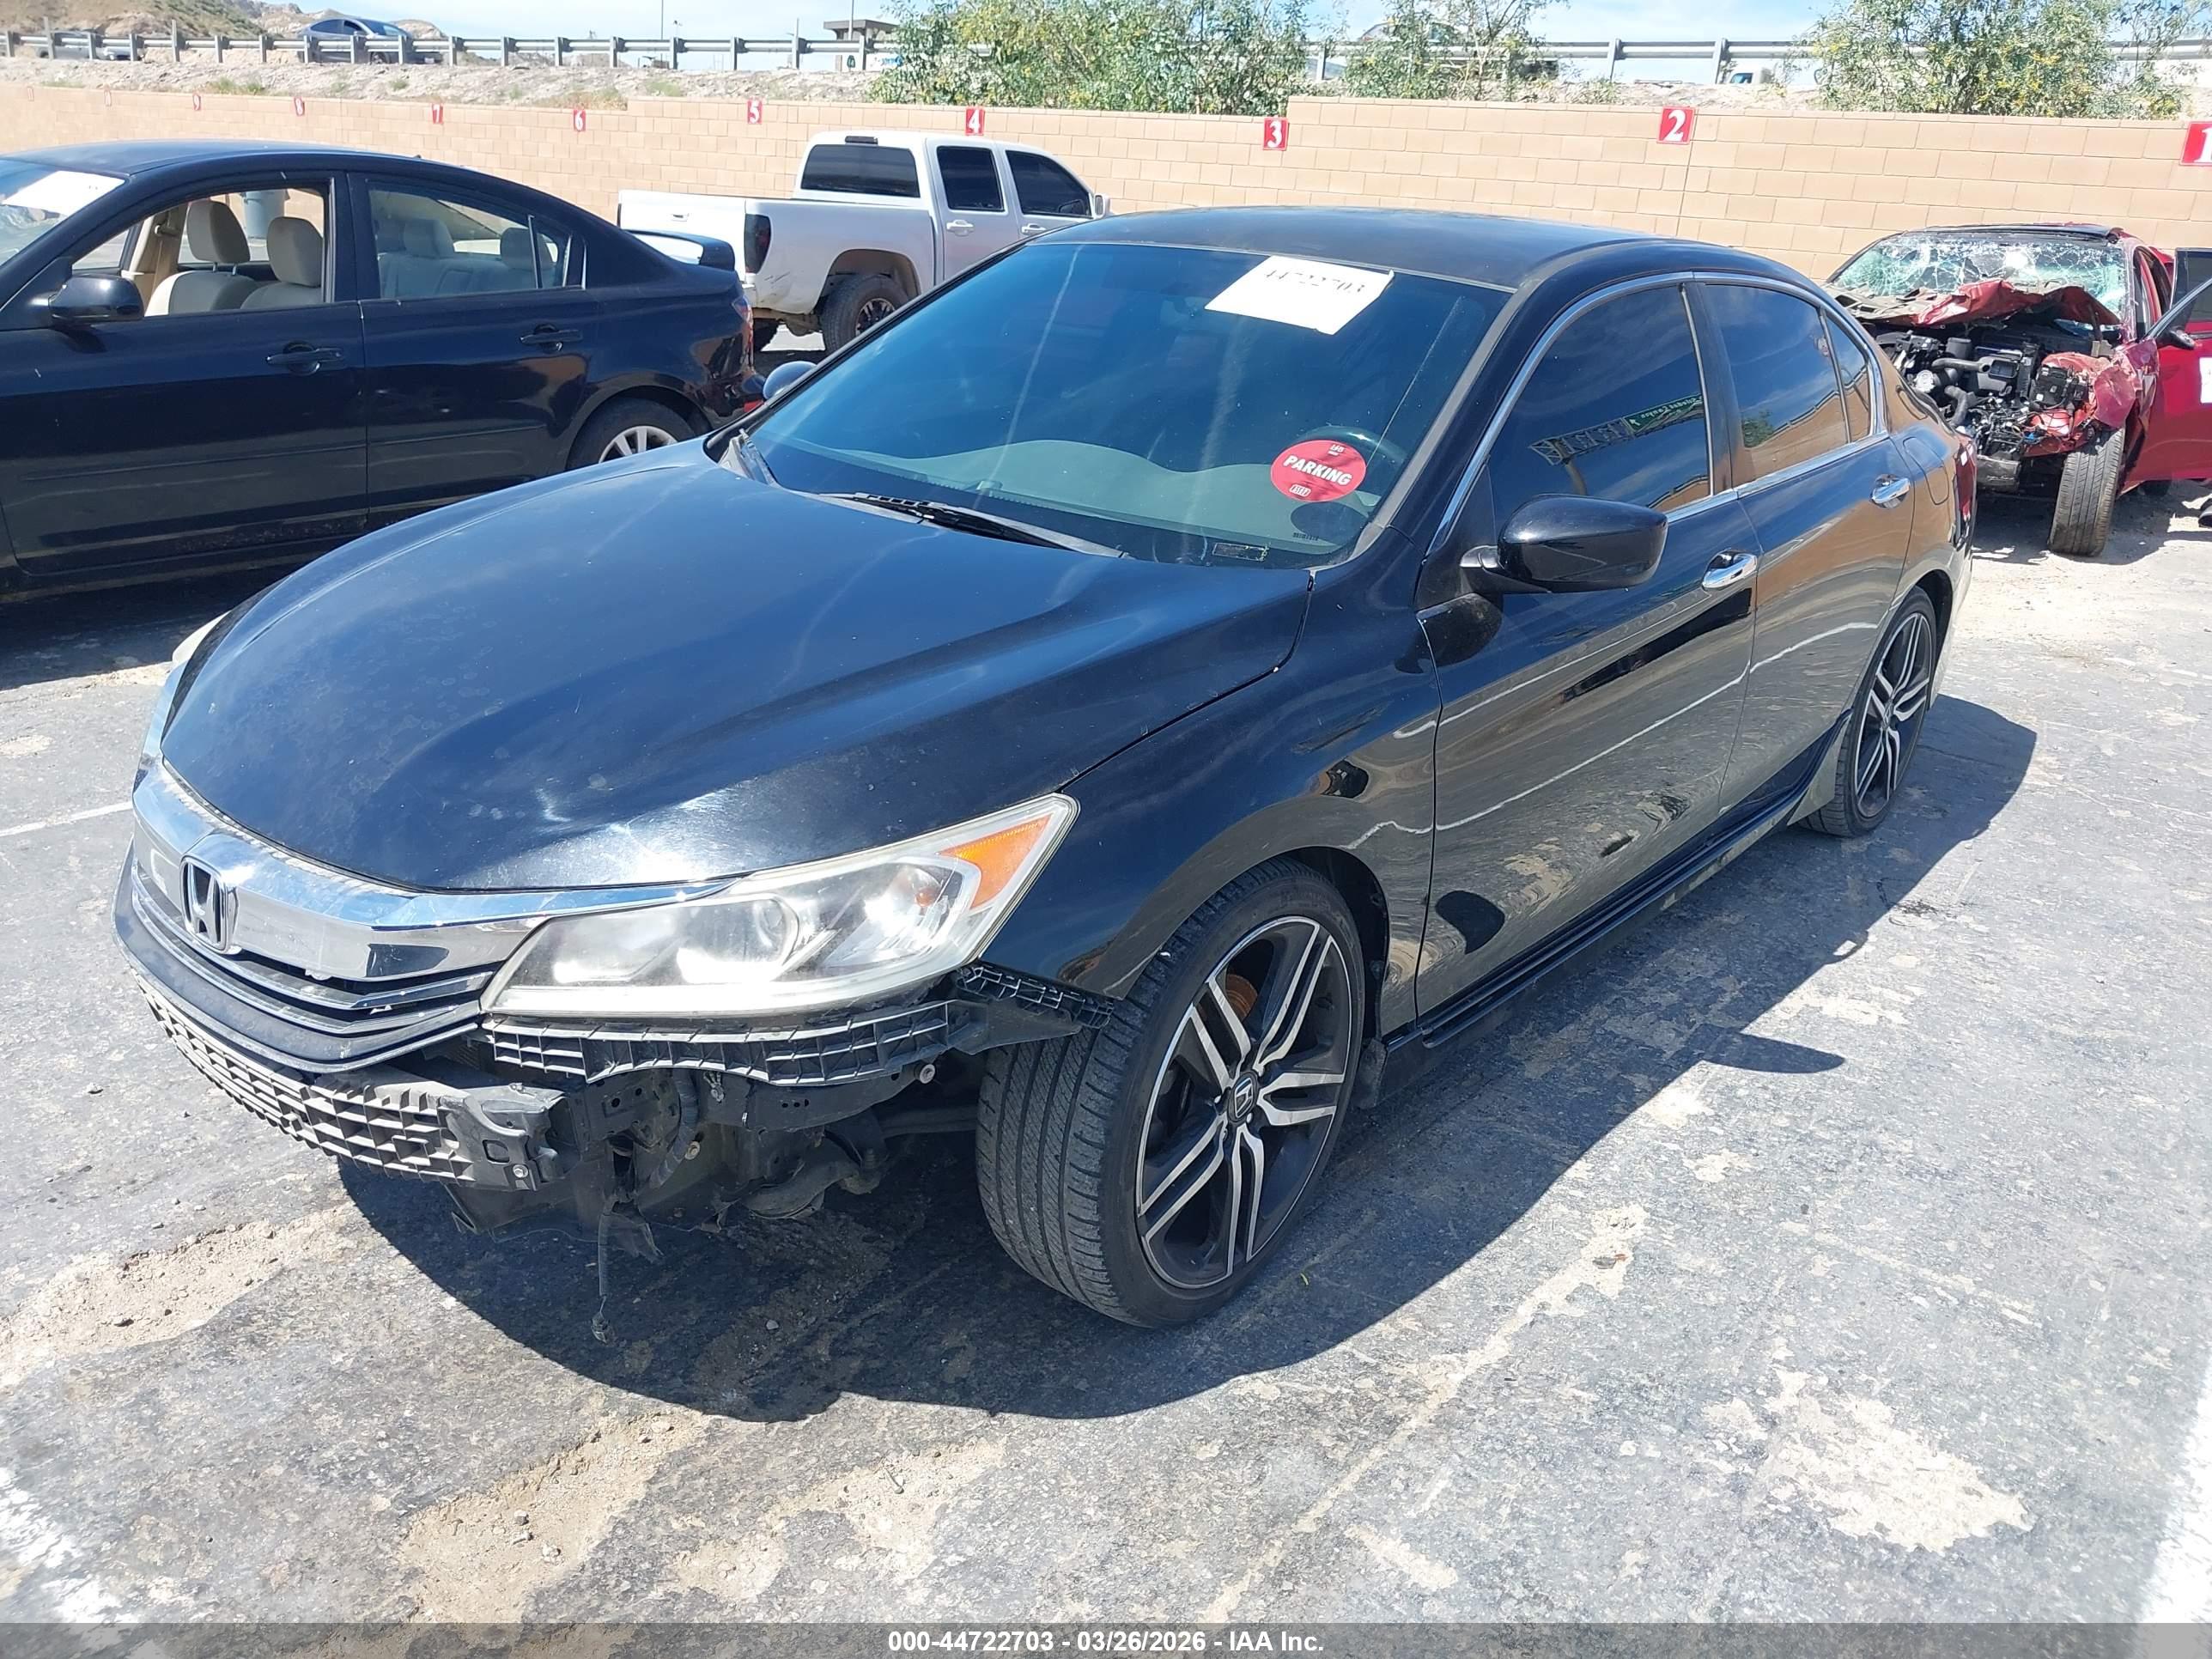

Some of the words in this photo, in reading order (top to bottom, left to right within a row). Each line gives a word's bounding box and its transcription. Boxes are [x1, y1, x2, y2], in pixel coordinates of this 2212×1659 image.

[295, 98, 302, 114] 8
[434, 104, 441, 124] 7
[750, 100, 759, 123] 5
[574, 110, 583, 131] 6
[969, 109, 981, 134] 4
[1662, 109, 1686, 142] 2
[1267, 120, 1283, 148] 3
[1283, 455, 1352, 486] PARKING
